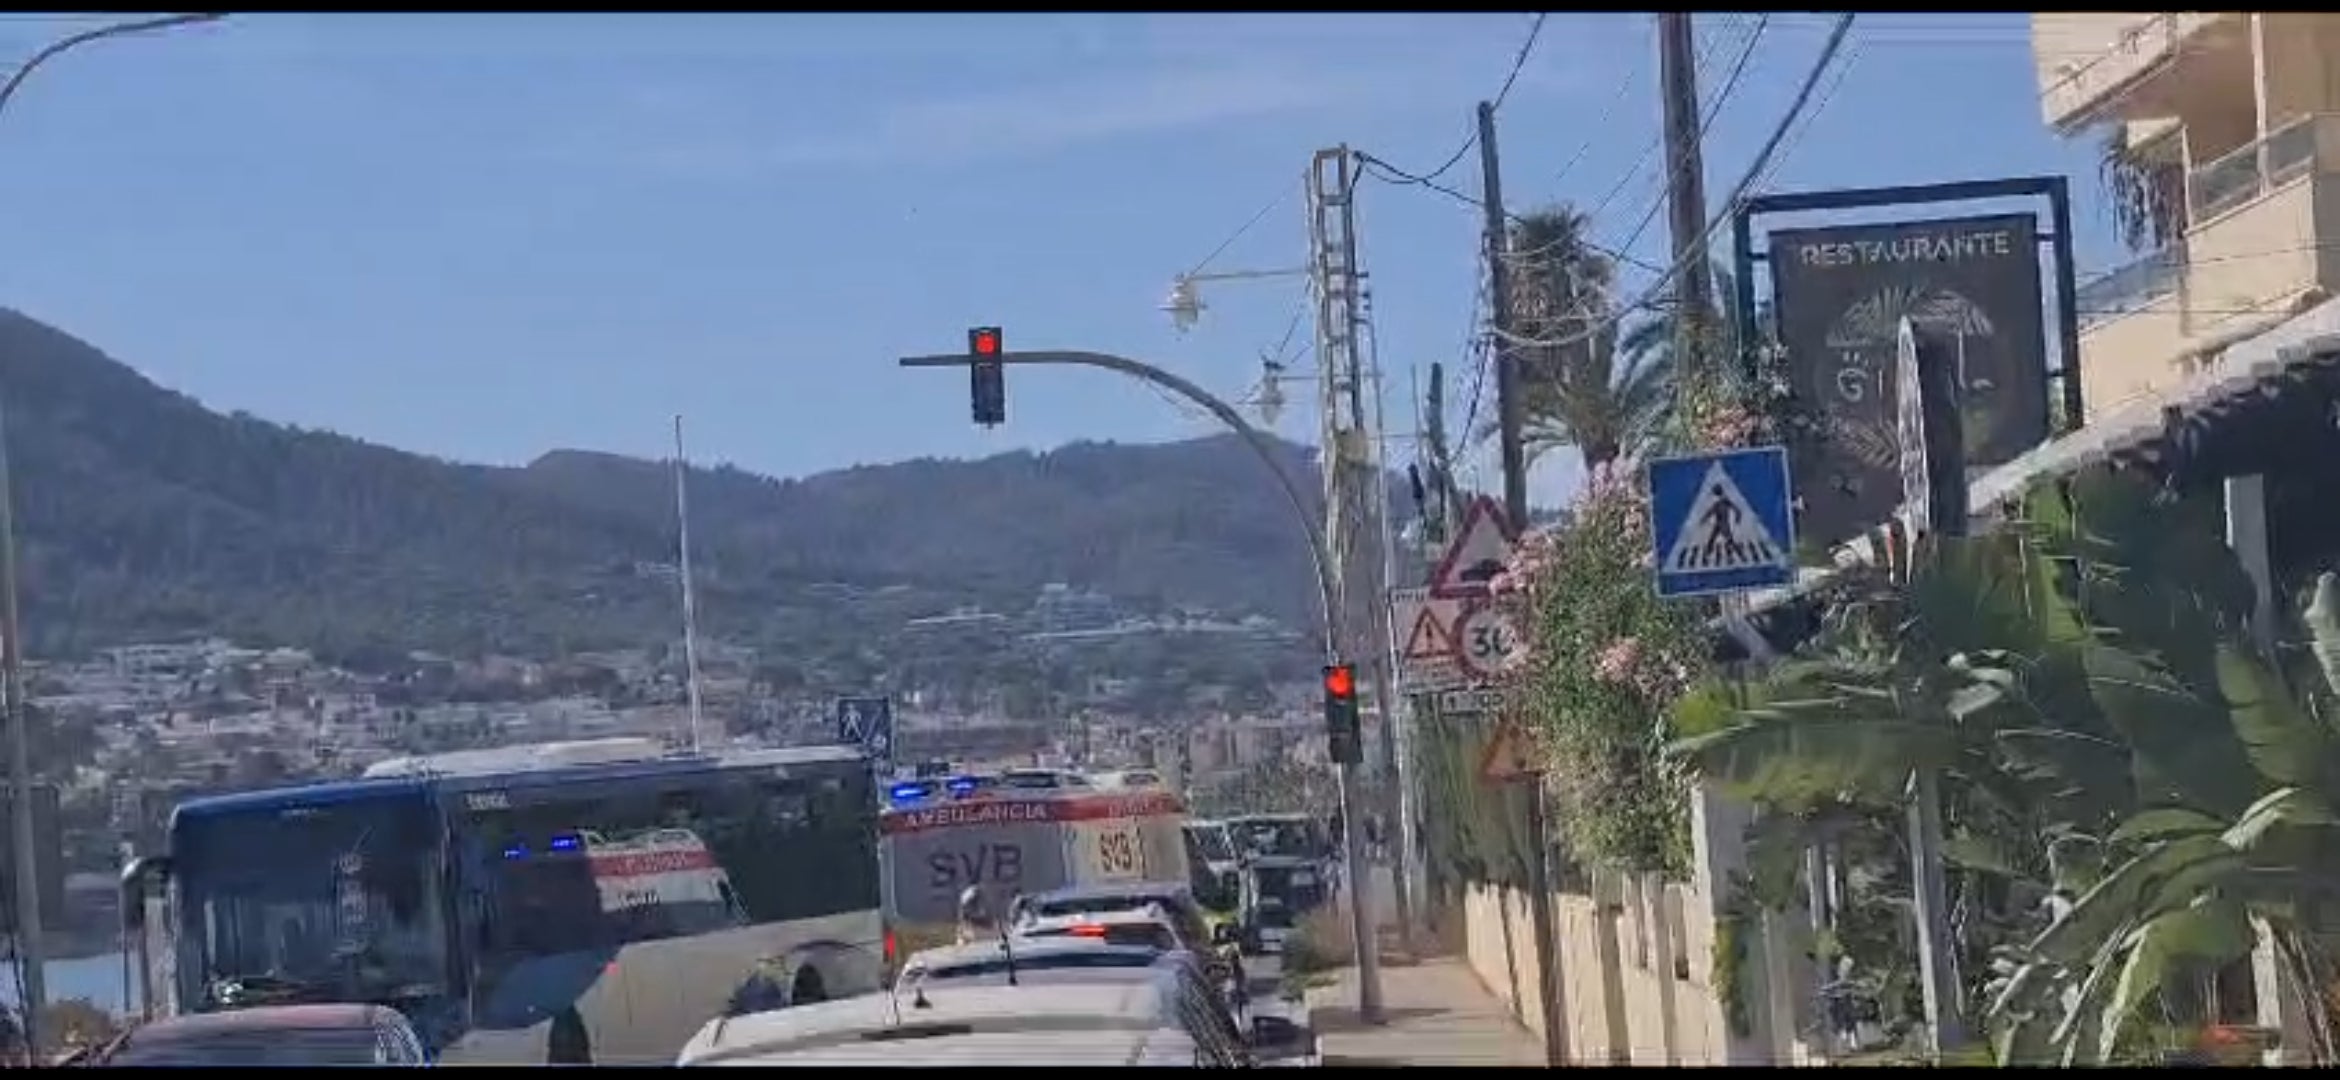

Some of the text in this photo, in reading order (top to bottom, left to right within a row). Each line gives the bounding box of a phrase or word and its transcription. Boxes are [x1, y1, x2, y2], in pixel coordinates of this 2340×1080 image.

[1801, 230, 2010, 266] RESTAURANTE
[904, 803, 1047, 827] AMBULANCIA
[928, 843, 1022, 887] SVB
